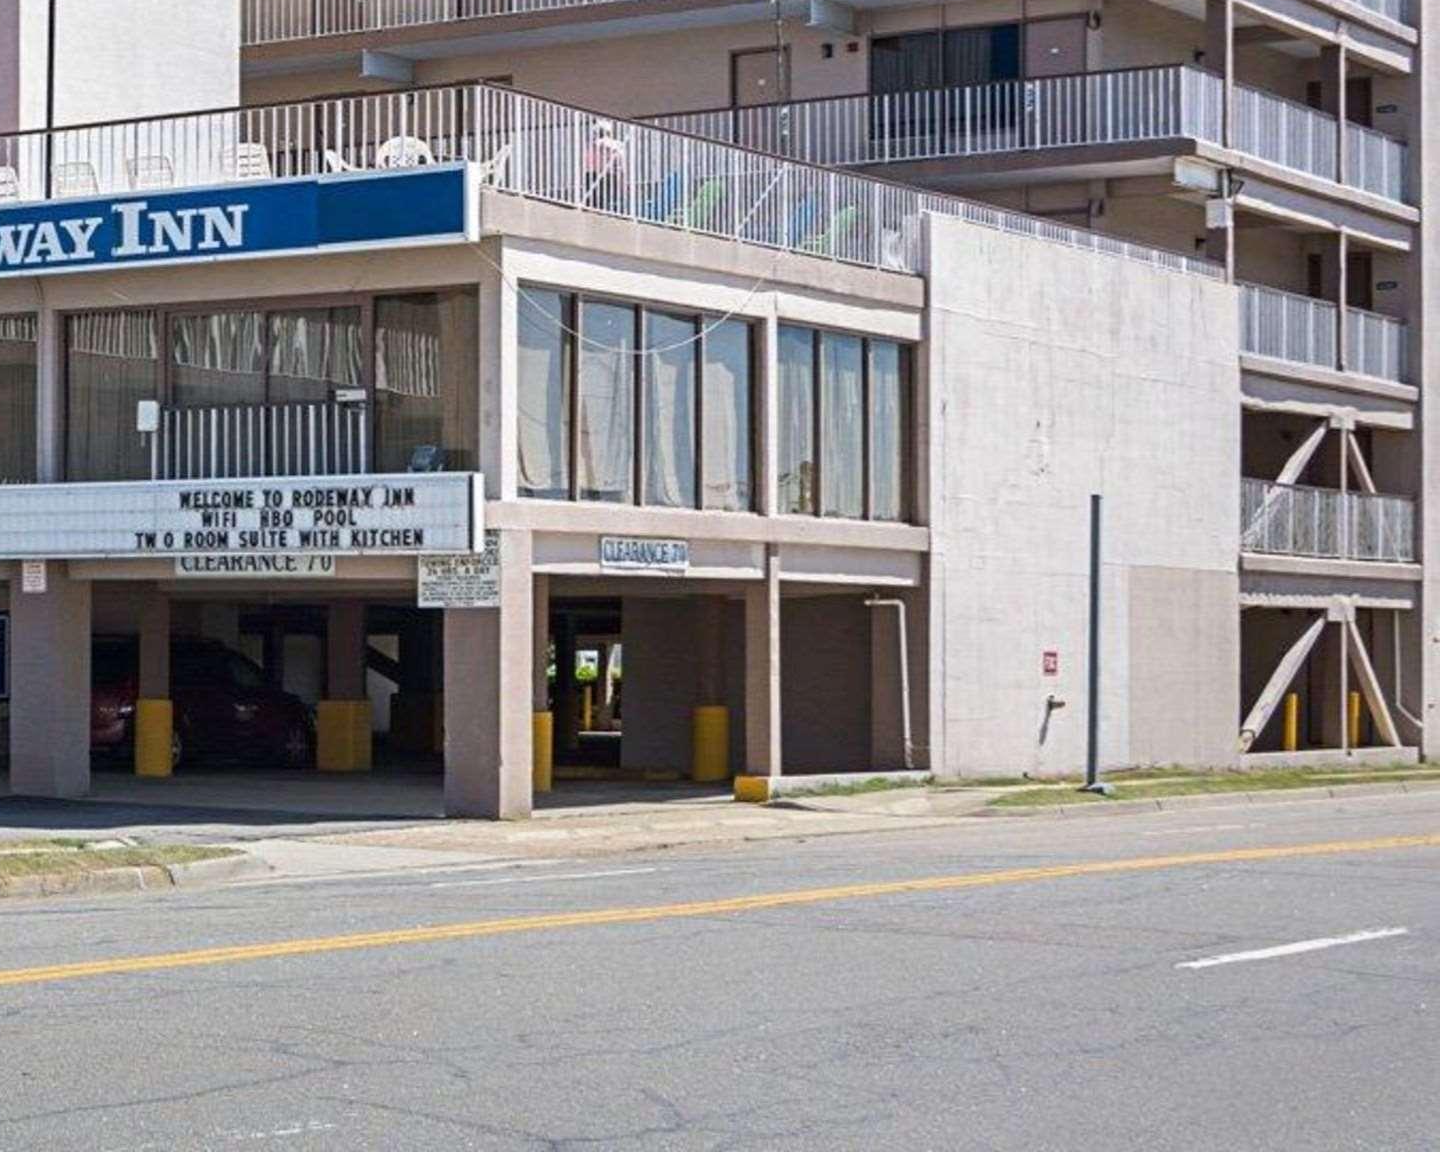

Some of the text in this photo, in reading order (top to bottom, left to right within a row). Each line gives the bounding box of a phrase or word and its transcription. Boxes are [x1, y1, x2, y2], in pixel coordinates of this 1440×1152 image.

[111, 200, 250, 257] INN
[179, 486, 416, 509] WELCOME TO RODEWAY INN
[201, 508, 358, 528] WIFI HBO POOL
[184, 530, 229, 548] ROOM
[238, 529, 288, 548] SUITE
[299, 528, 340, 548] WITH
[350, 527, 424, 547] KITCHEN
[180, 554, 298, 573] CLEARANCE
